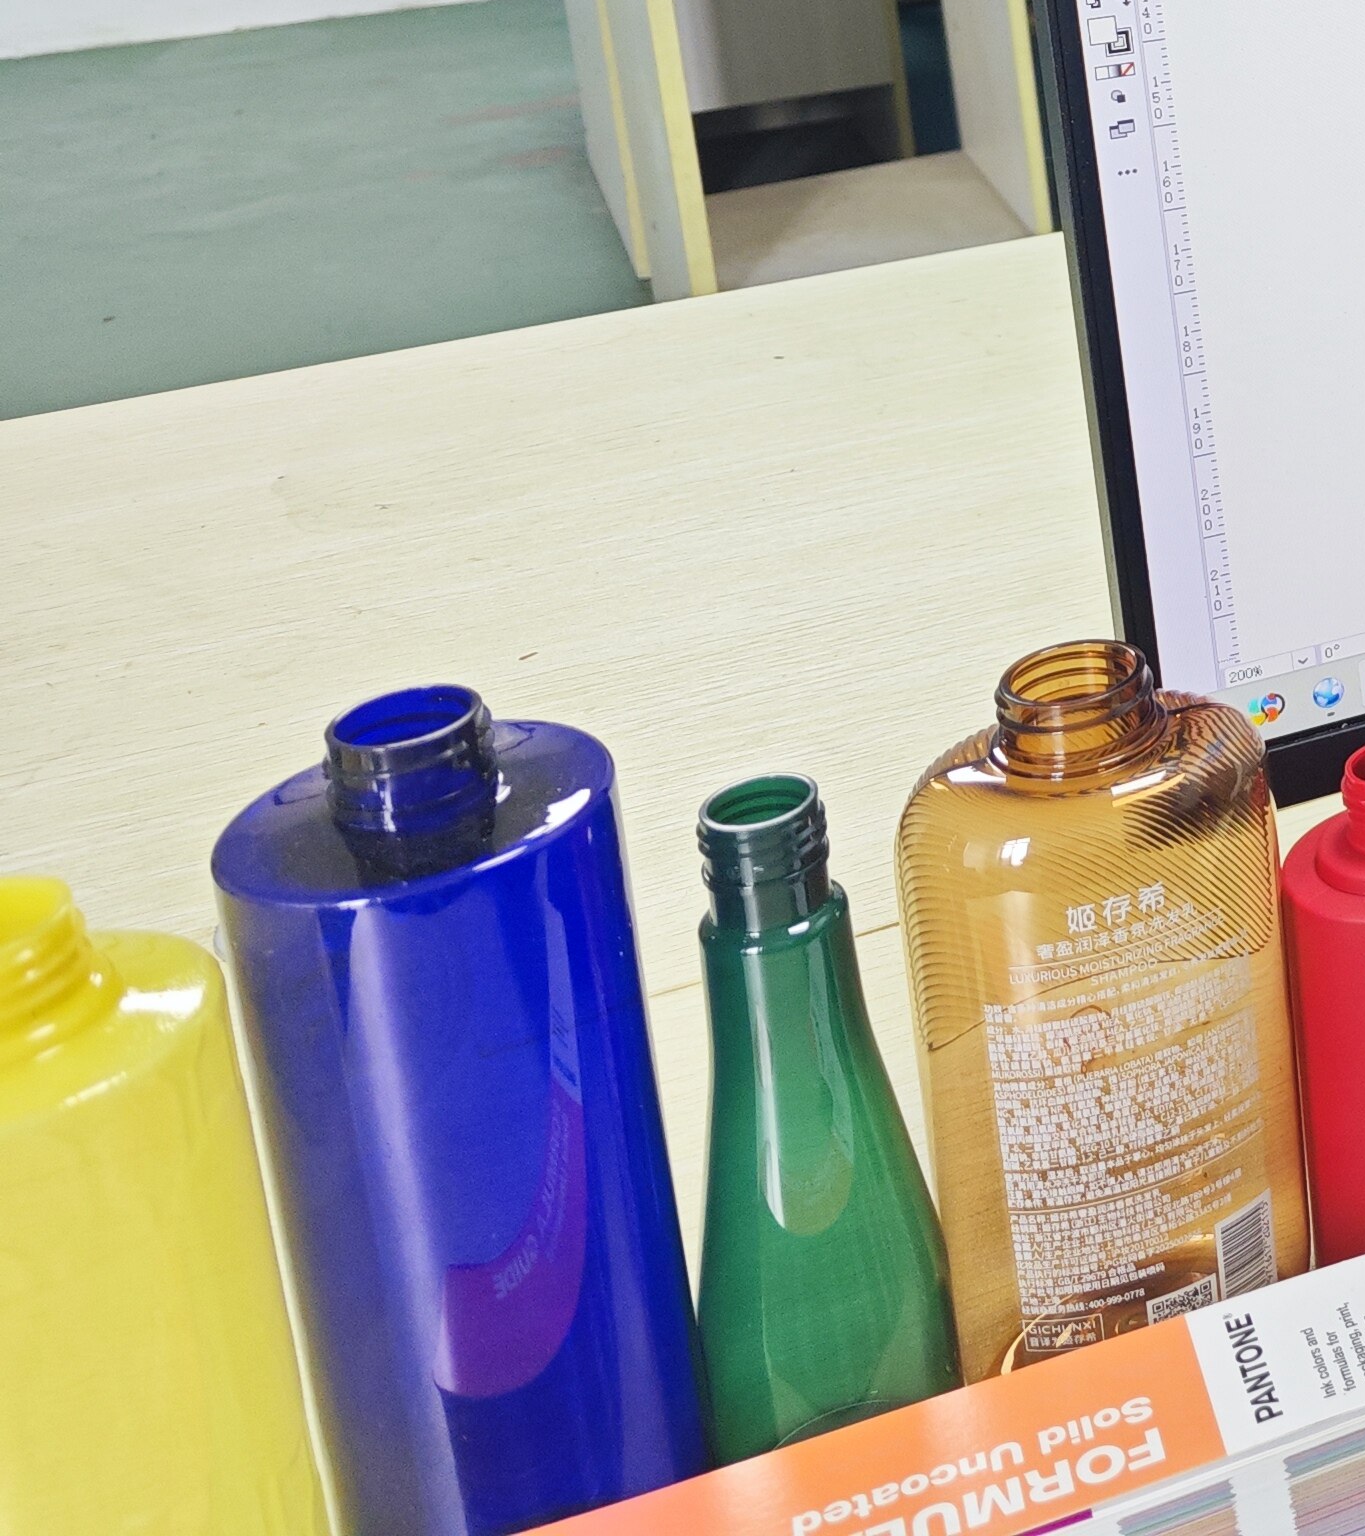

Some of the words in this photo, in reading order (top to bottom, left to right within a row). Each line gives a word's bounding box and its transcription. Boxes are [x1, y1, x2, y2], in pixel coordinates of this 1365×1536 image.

[1228, 664, 1264, 684] 200%
[1065, 880, 1166, 935] 姬存希
[1008, 965, 1079, 986] LUXURIOUS
[1079, 943, 1164, 977] MOISTURIZING
[1089, 957, 1158, 987] SHAMPOO
[1224, 1312, 1284, 1425] PANTONE
[1037, 1396, 1154, 1455] Solid
[790, 1440, 1026, 1536] Uncoated
